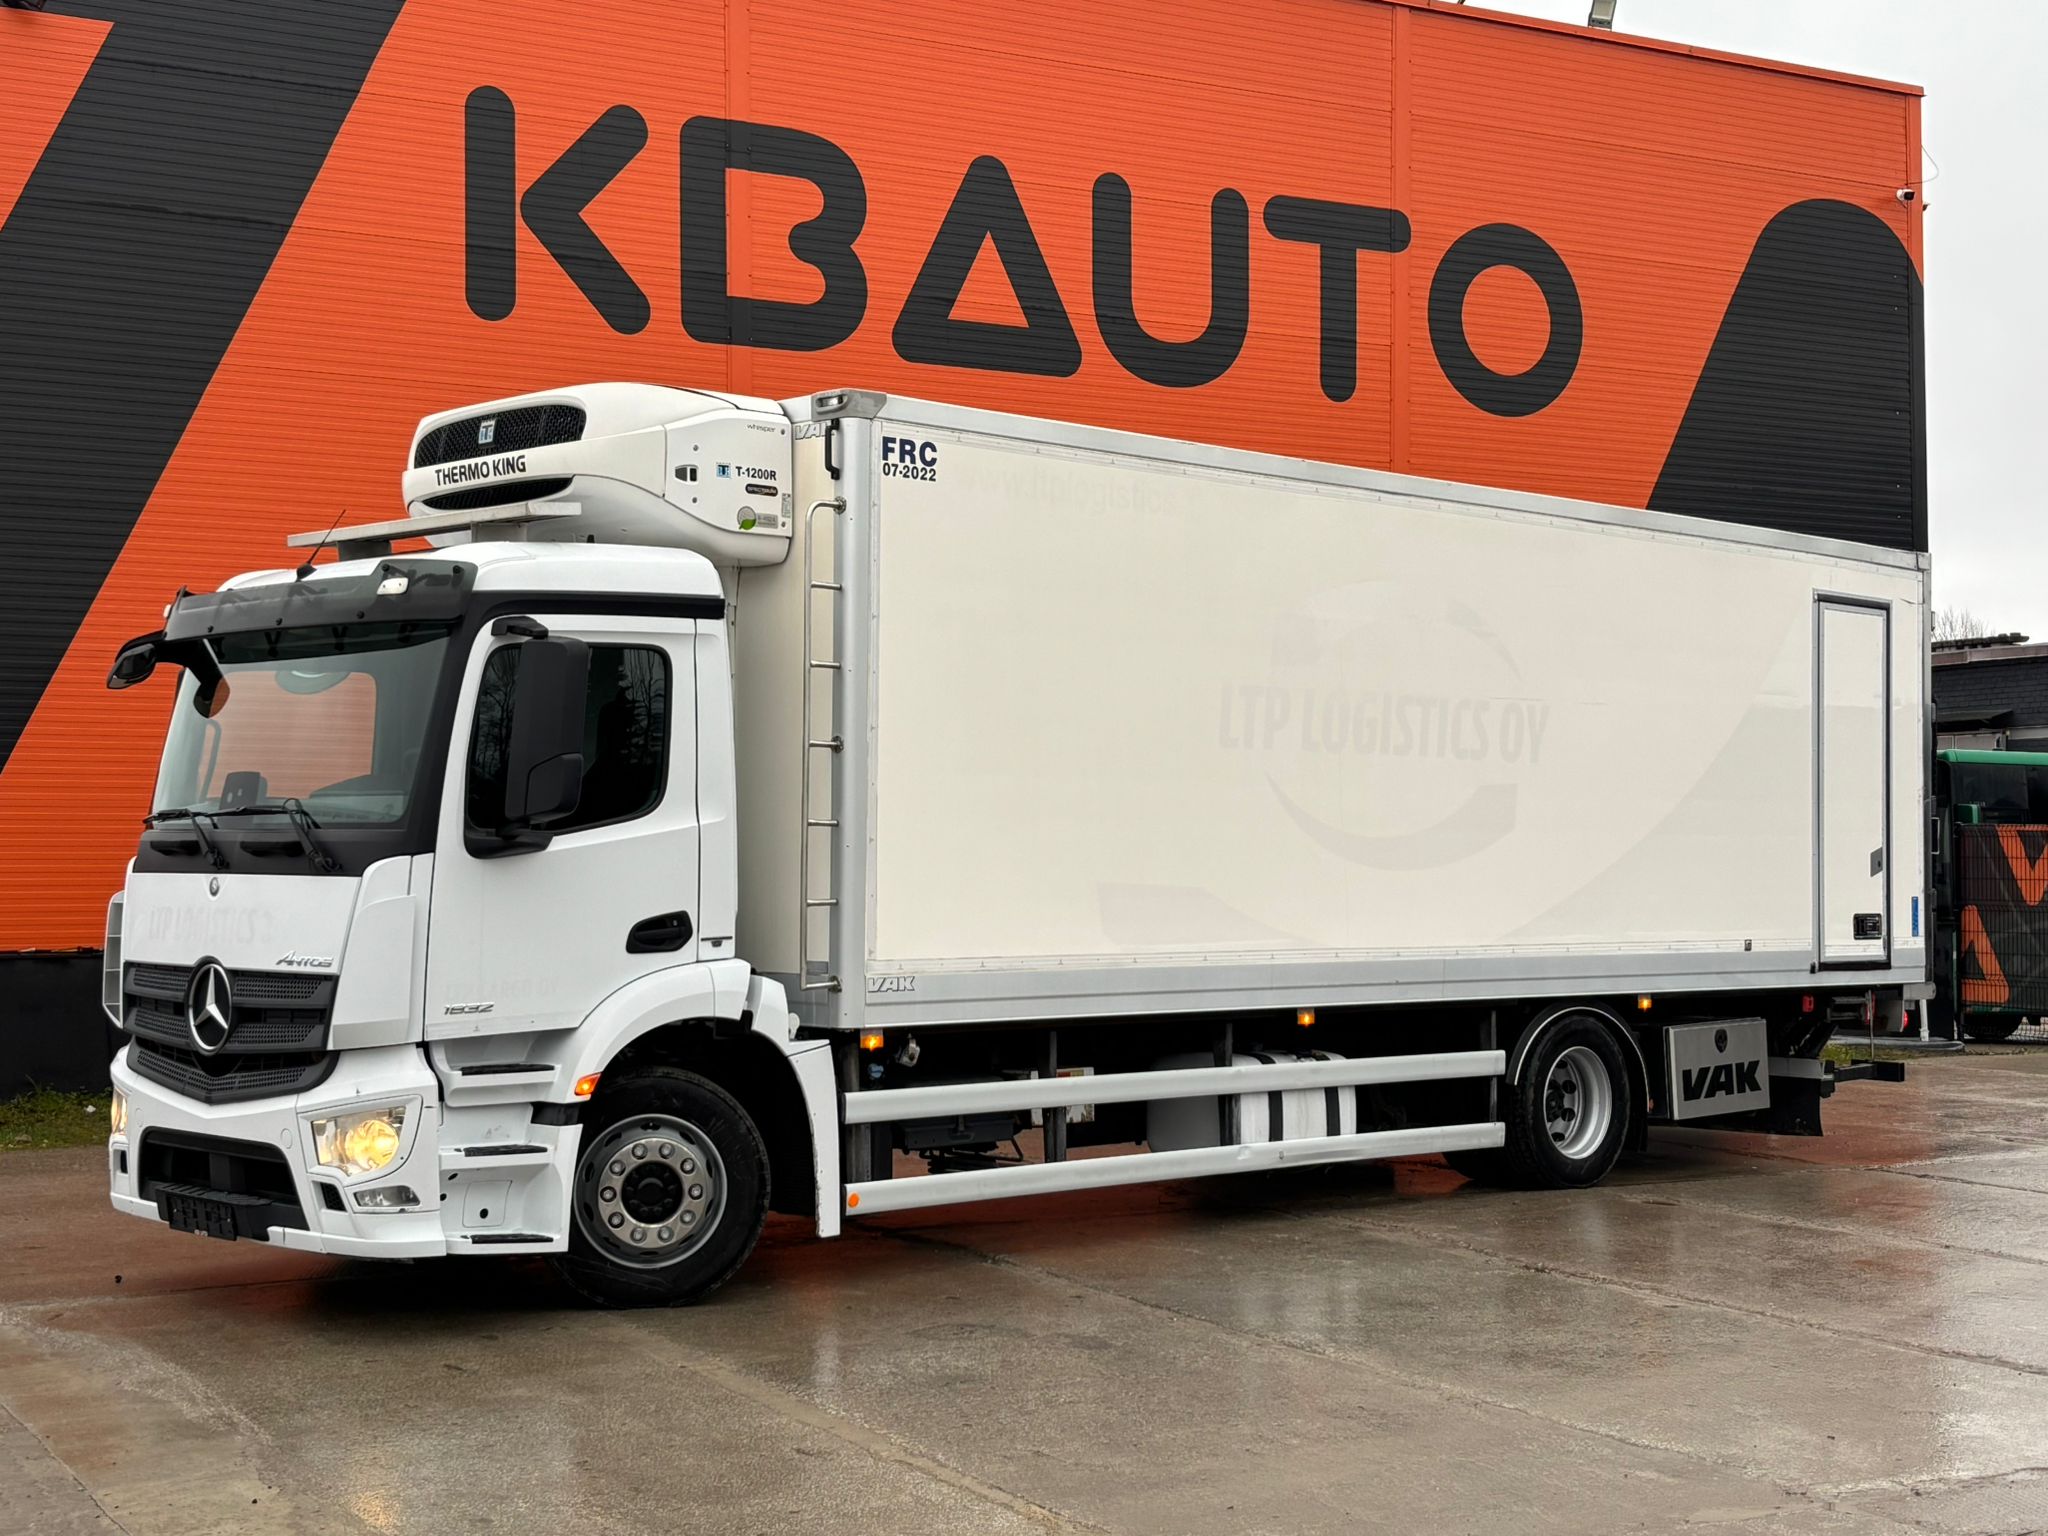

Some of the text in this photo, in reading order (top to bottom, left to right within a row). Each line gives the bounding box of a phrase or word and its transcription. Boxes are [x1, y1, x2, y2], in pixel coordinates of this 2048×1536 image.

[794, 420, 836, 440] VA
[882, 436, 938, 468] FRC
[434, 454, 527, 487] THERMO KING
[735, 466, 777, 481] T-1200R
[882, 462, 937, 482] 07-2022
[1218, 682, 1551, 765] LTP LOGISTICS OY
[867, 976, 916, 993] VAK
[444, 1002, 495, 1015] 1832
[1682, 1060, 1762, 1102] VAK
